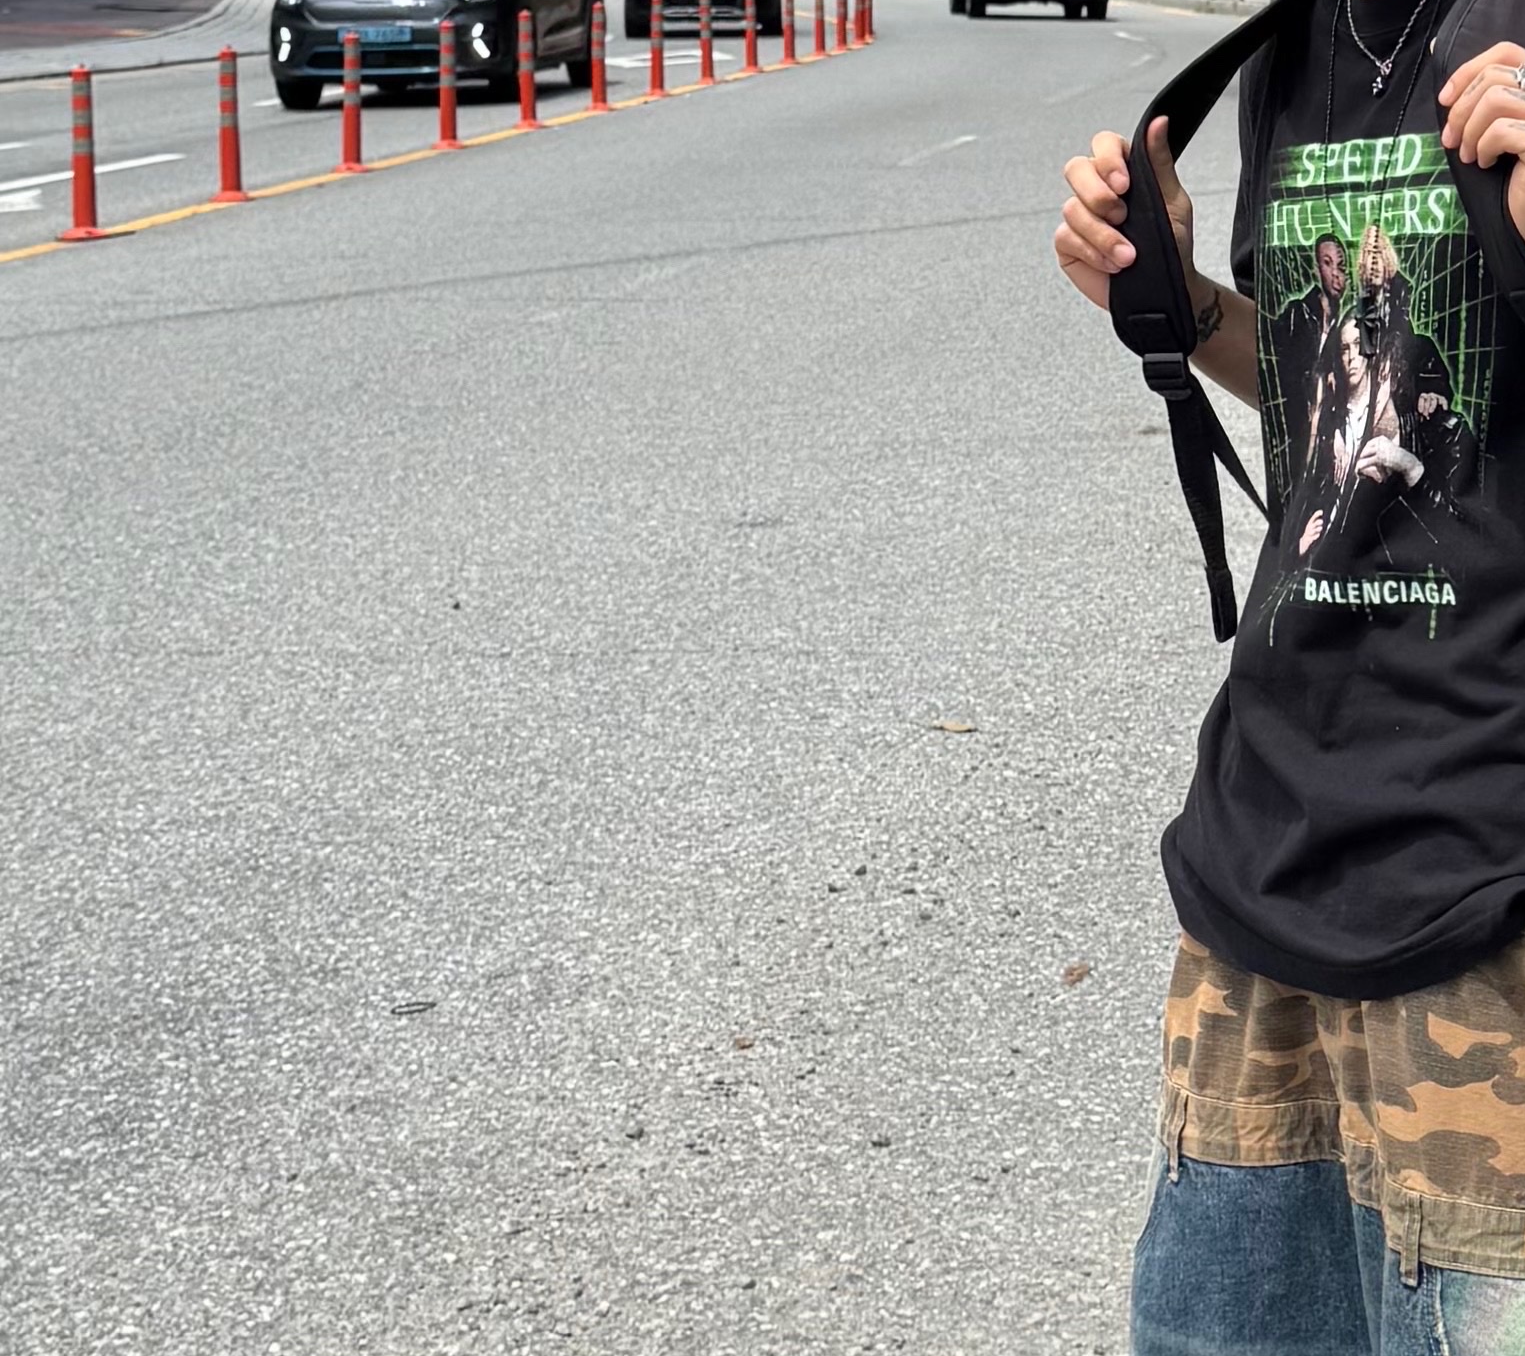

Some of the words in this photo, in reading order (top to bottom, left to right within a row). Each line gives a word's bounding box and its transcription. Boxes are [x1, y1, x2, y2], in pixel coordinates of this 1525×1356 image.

[1296, 133, 1423, 188] SPEED
[1271, 188, 1451, 247] HUNTERS
[1304, 576, 1457, 606] BALENCIAGA
